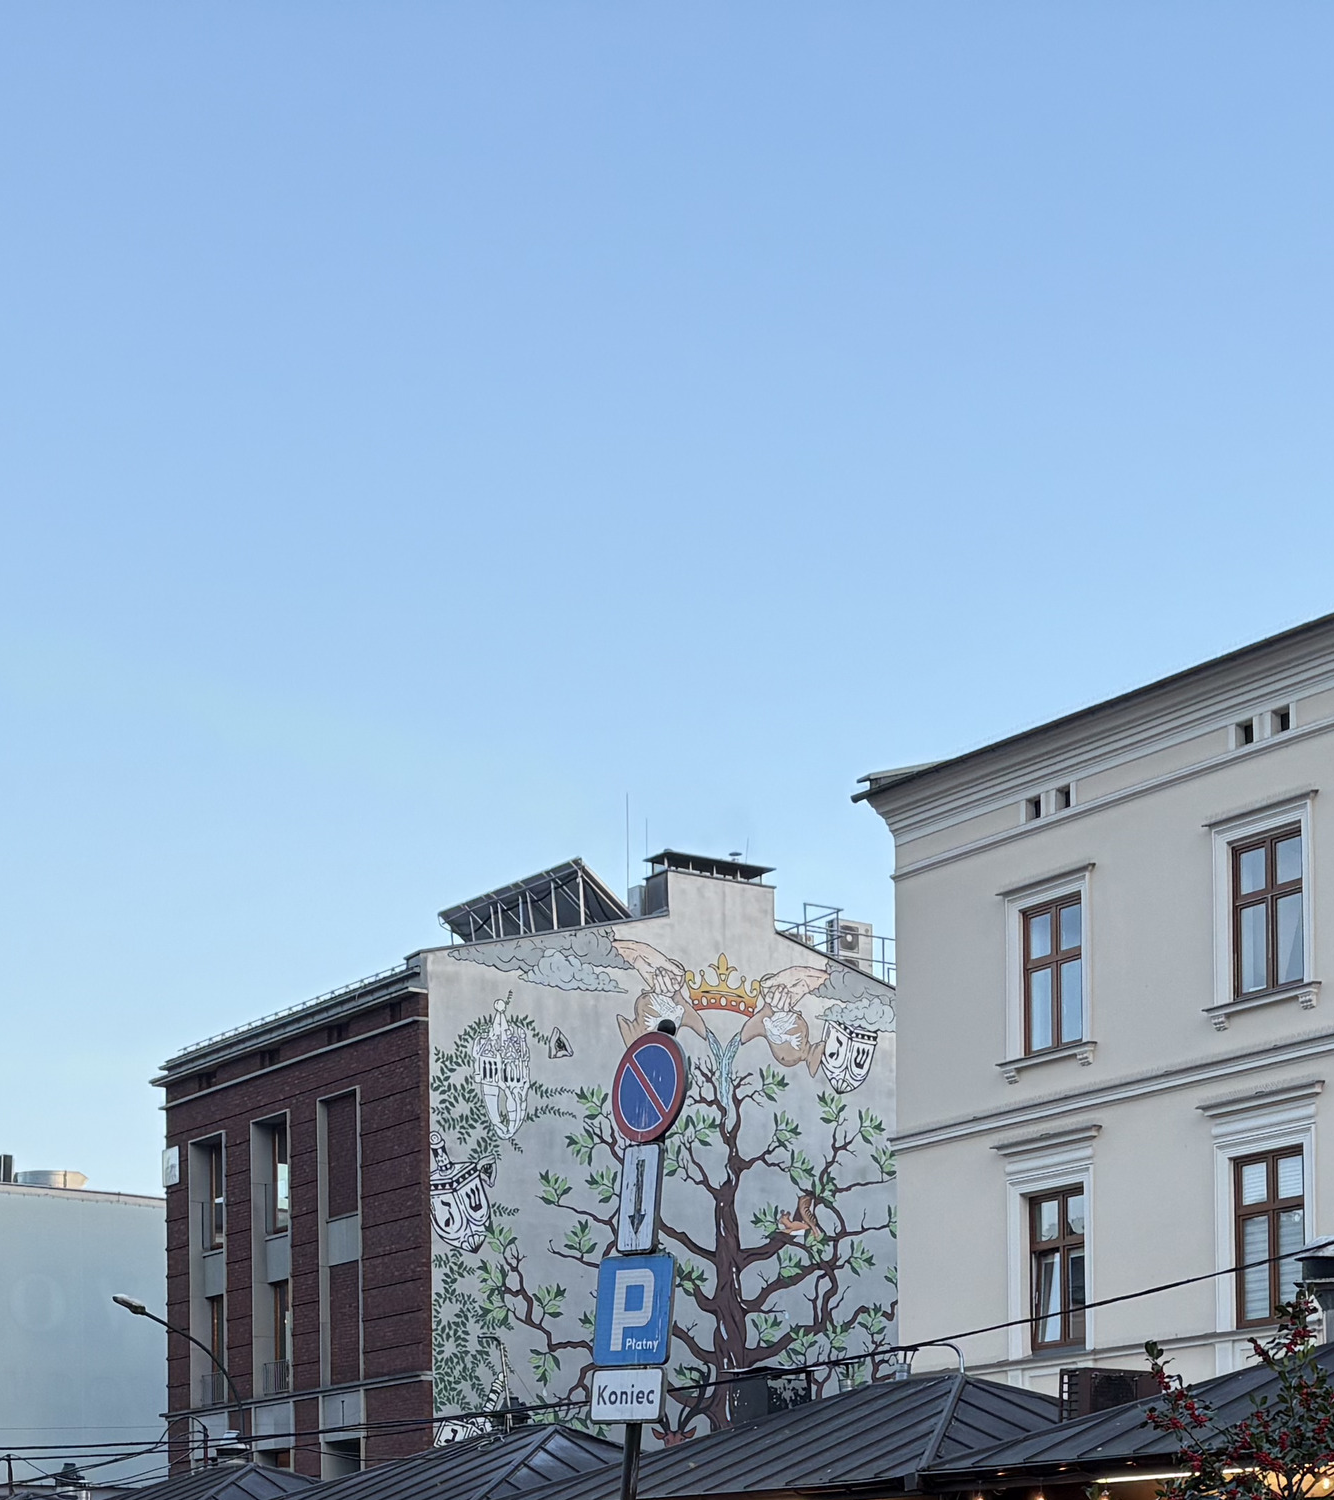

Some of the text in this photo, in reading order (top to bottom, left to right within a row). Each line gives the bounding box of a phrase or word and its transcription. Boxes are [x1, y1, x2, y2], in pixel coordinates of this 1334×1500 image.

[610, 1269, 654, 1351] P
[625, 1337, 658, 1353] Płatny
[597, 1384, 655, 1406] Koniec
